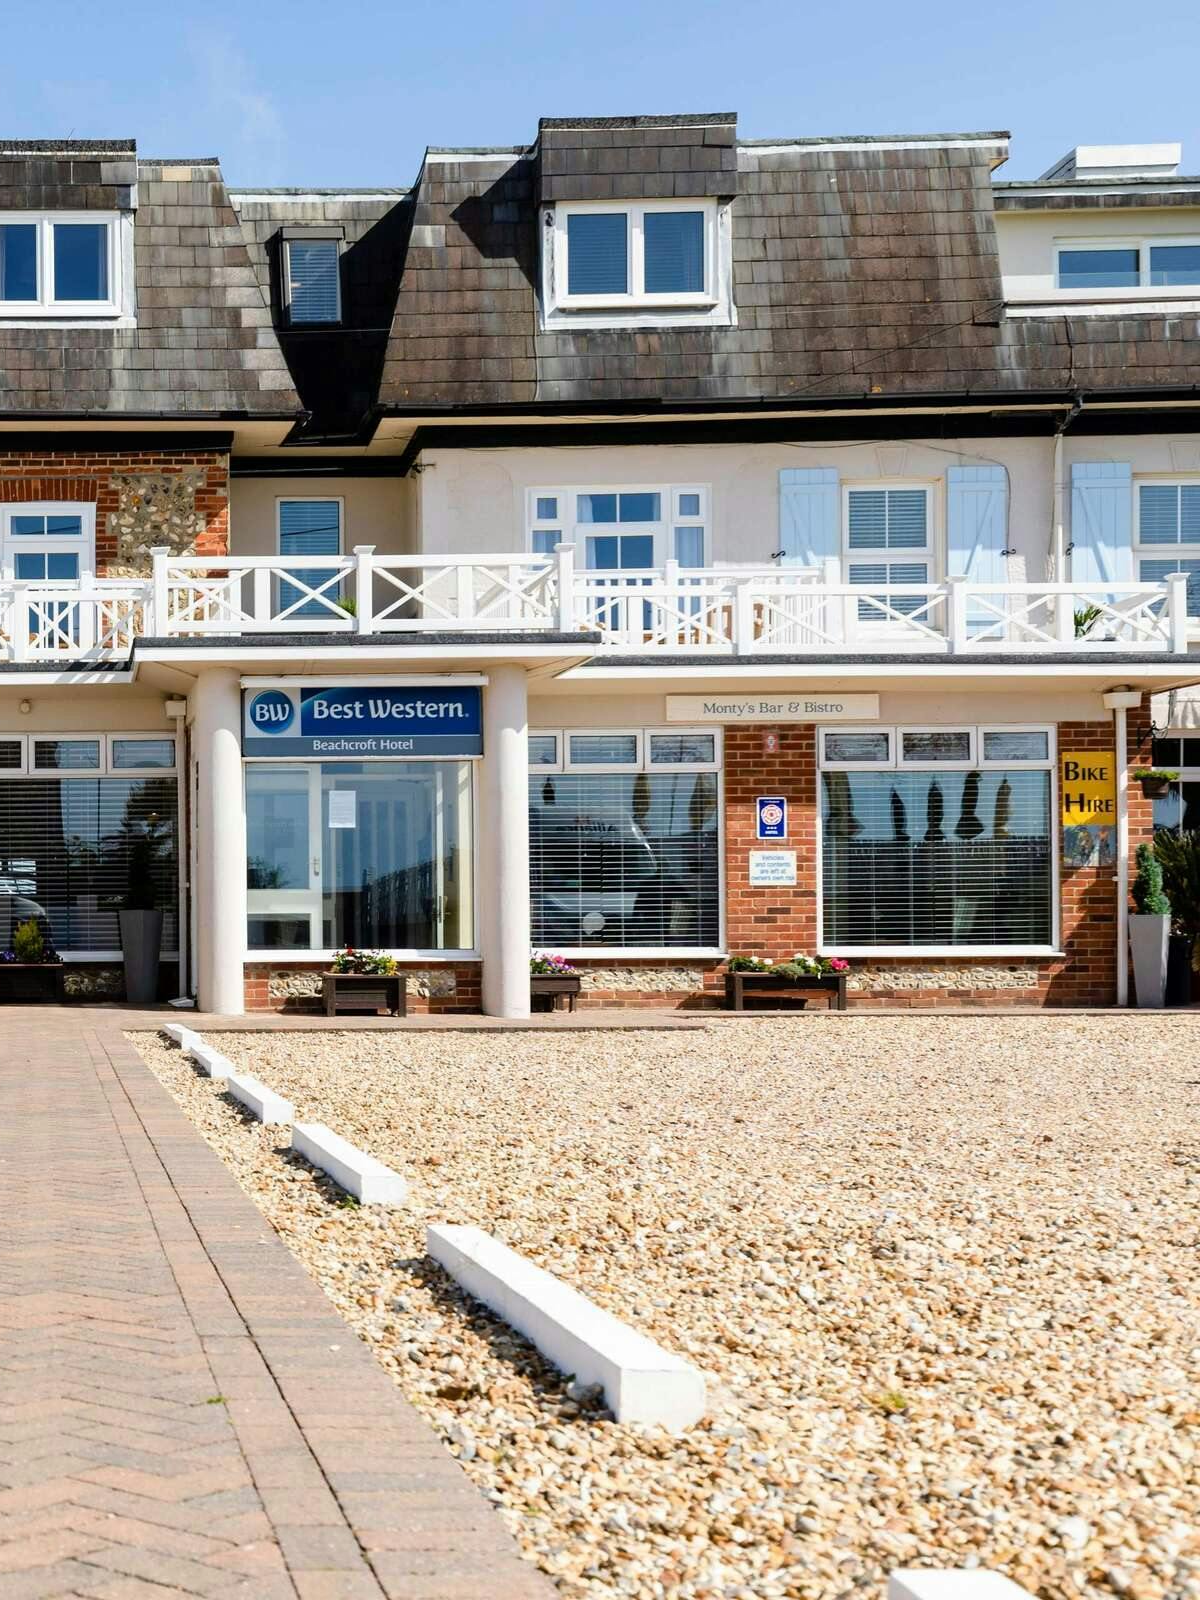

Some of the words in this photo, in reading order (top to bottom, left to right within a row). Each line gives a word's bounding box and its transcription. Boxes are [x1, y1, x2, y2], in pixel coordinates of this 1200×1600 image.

[255, 703, 290, 722] BW
[313, 699, 365, 719] Best
[703, 702, 755, 717] Monty's
[759, 702, 783, 714] Bar
[788, 702, 800, 713] &
[804, 701, 844, 713] Bistro
[313, 739, 377, 751] Beachcroft
[380, 738, 414, 750] Hotel
[1064, 761, 1109, 781] BIKE
[1065, 793, 1114, 813] HIRE
